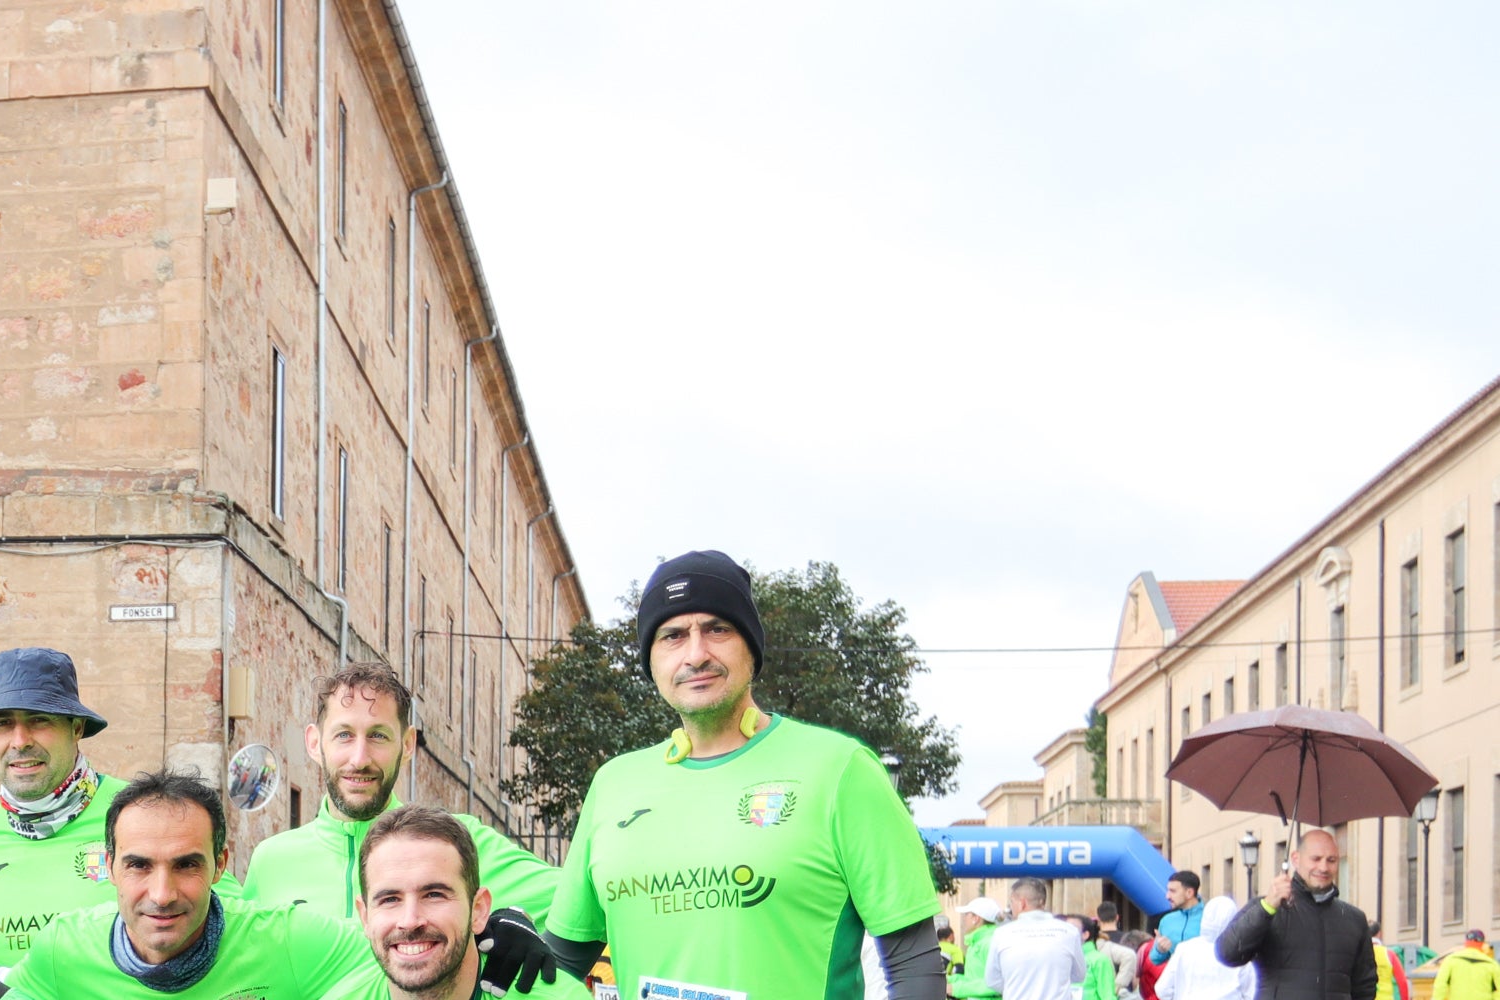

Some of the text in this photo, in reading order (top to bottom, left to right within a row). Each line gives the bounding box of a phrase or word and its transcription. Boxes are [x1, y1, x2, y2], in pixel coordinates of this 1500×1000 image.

[123, 608, 162, 617] FONSECA
[936, 841, 999, 865] NTT
[606, 864, 754, 902] SANMAXIMO
[651, 888, 740, 915] TELECOM
